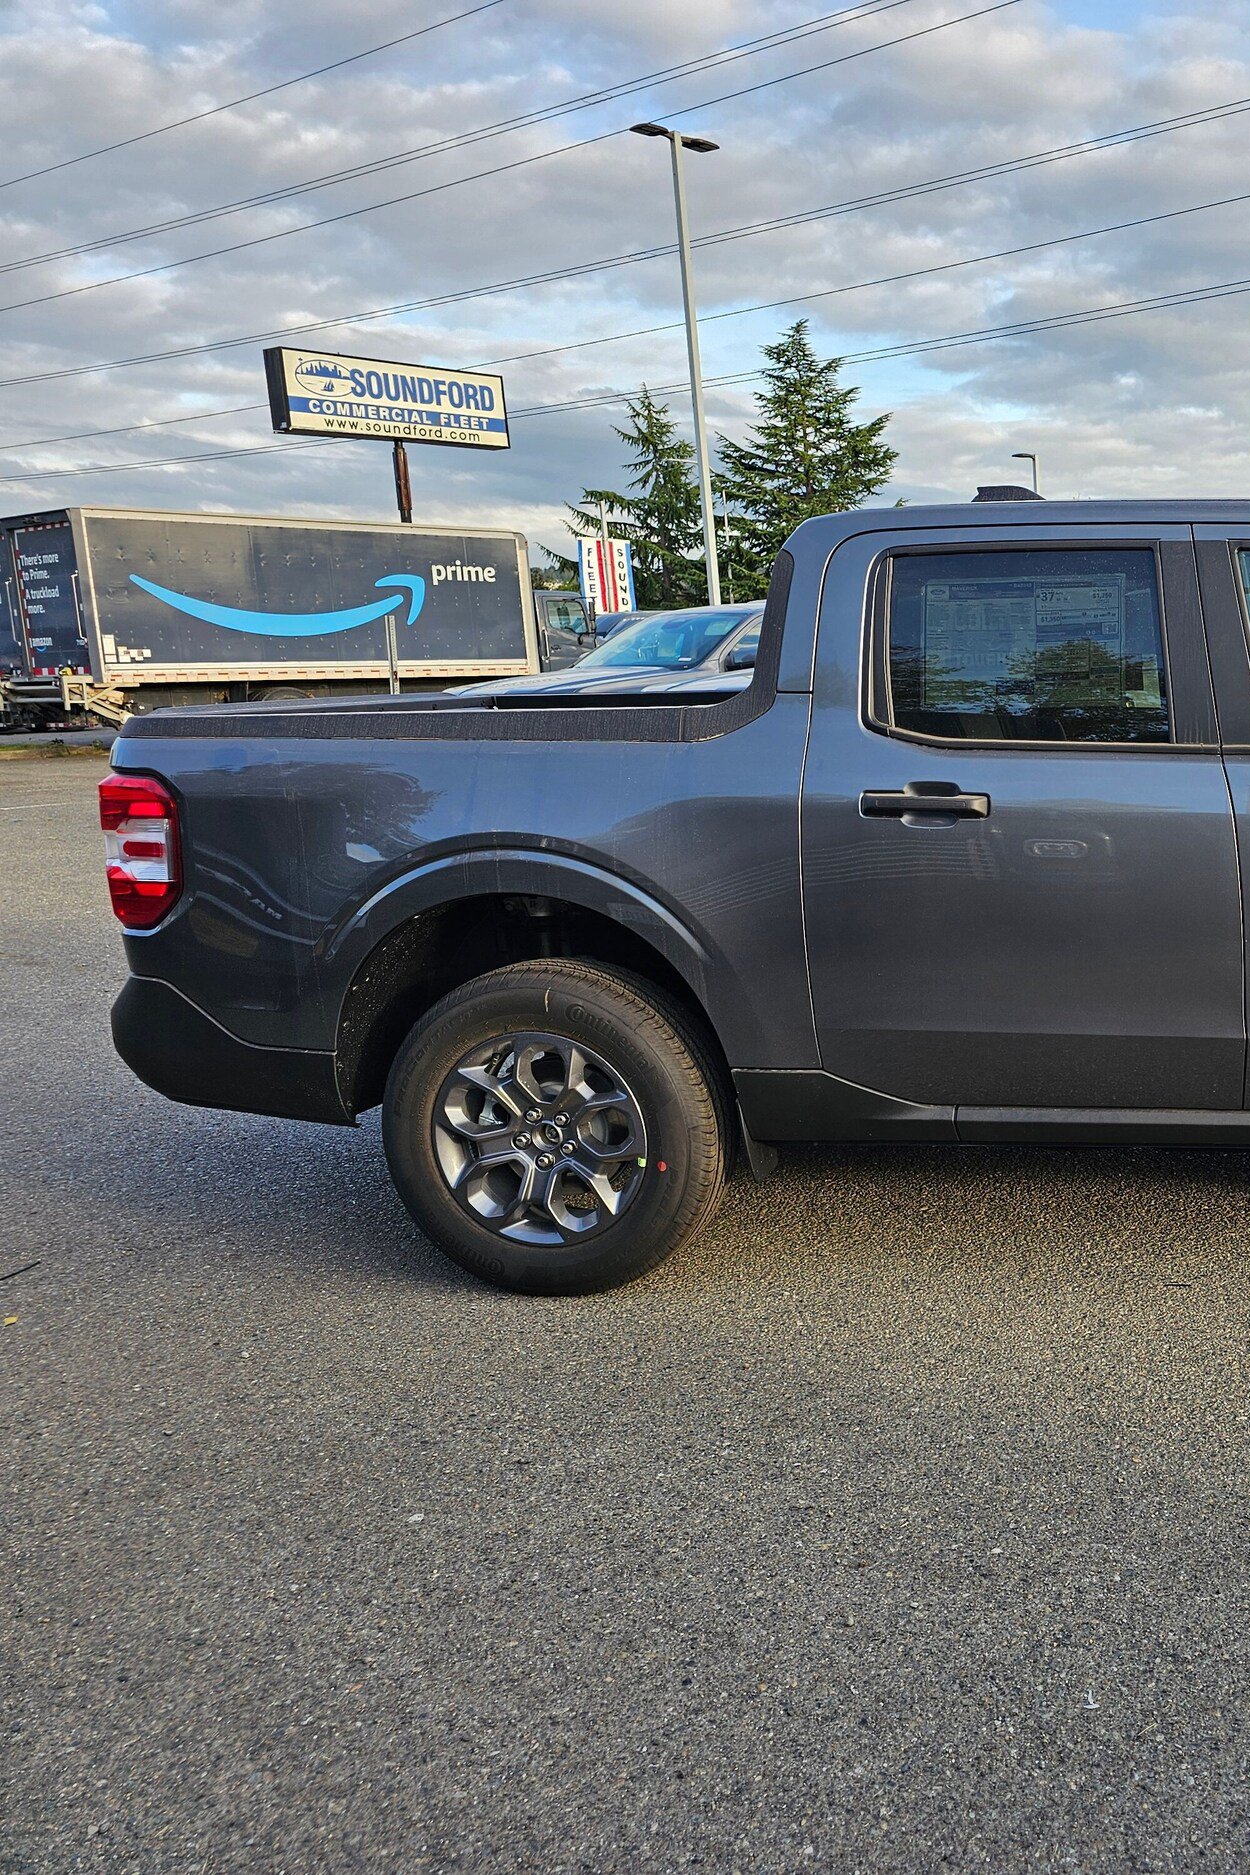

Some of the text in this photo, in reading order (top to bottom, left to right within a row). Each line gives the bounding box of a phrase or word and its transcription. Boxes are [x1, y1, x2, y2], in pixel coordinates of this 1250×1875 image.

[349, 368, 495, 412] SOUNDFORD
[308, 399, 489, 430] COMMERCIAL FLEET
[324, 416, 481, 442] www.soundford.com
[20, 553, 59, 567] There's more
[22, 568, 50, 580] to Prime.
[432, 558, 496, 585] prime
[617, 548, 629, 606] SOUND
[26, 585, 60, 600] A truckload
[1041, 591, 1054, 601] 37
[28, 604, 45, 614] more.
[32, 637, 53, 647] amazon
